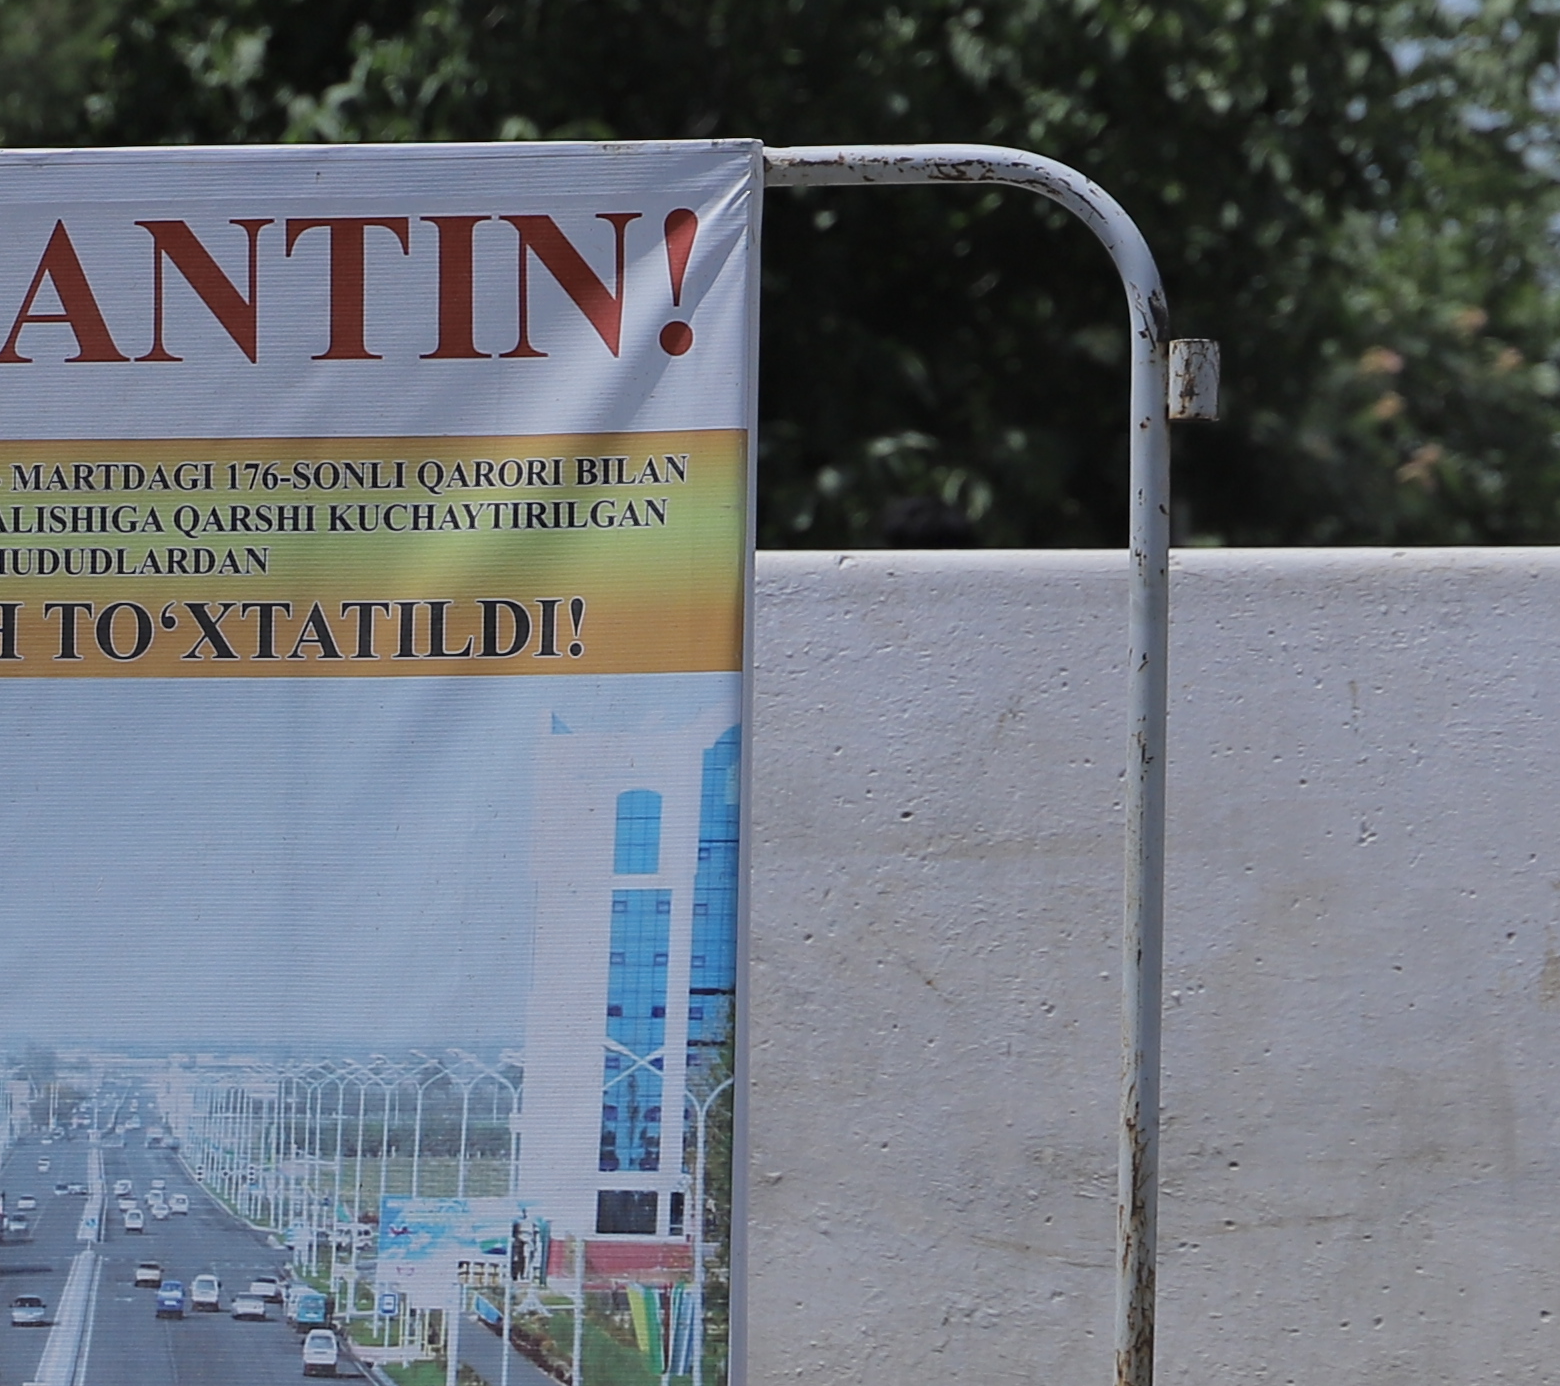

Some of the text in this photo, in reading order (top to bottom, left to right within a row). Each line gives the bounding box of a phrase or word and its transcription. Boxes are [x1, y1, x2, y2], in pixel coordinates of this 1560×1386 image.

[13, 463, 213, 491] MARTDAGI
[228, 461, 405, 490] 176-SONLI
[417, 459, 561, 495] QARORI
[575, 456, 685, 486] BILAN
[173, 504, 315, 539] QARSHI
[328, 499, 665, 532] KUCHAYTIRILGAN
